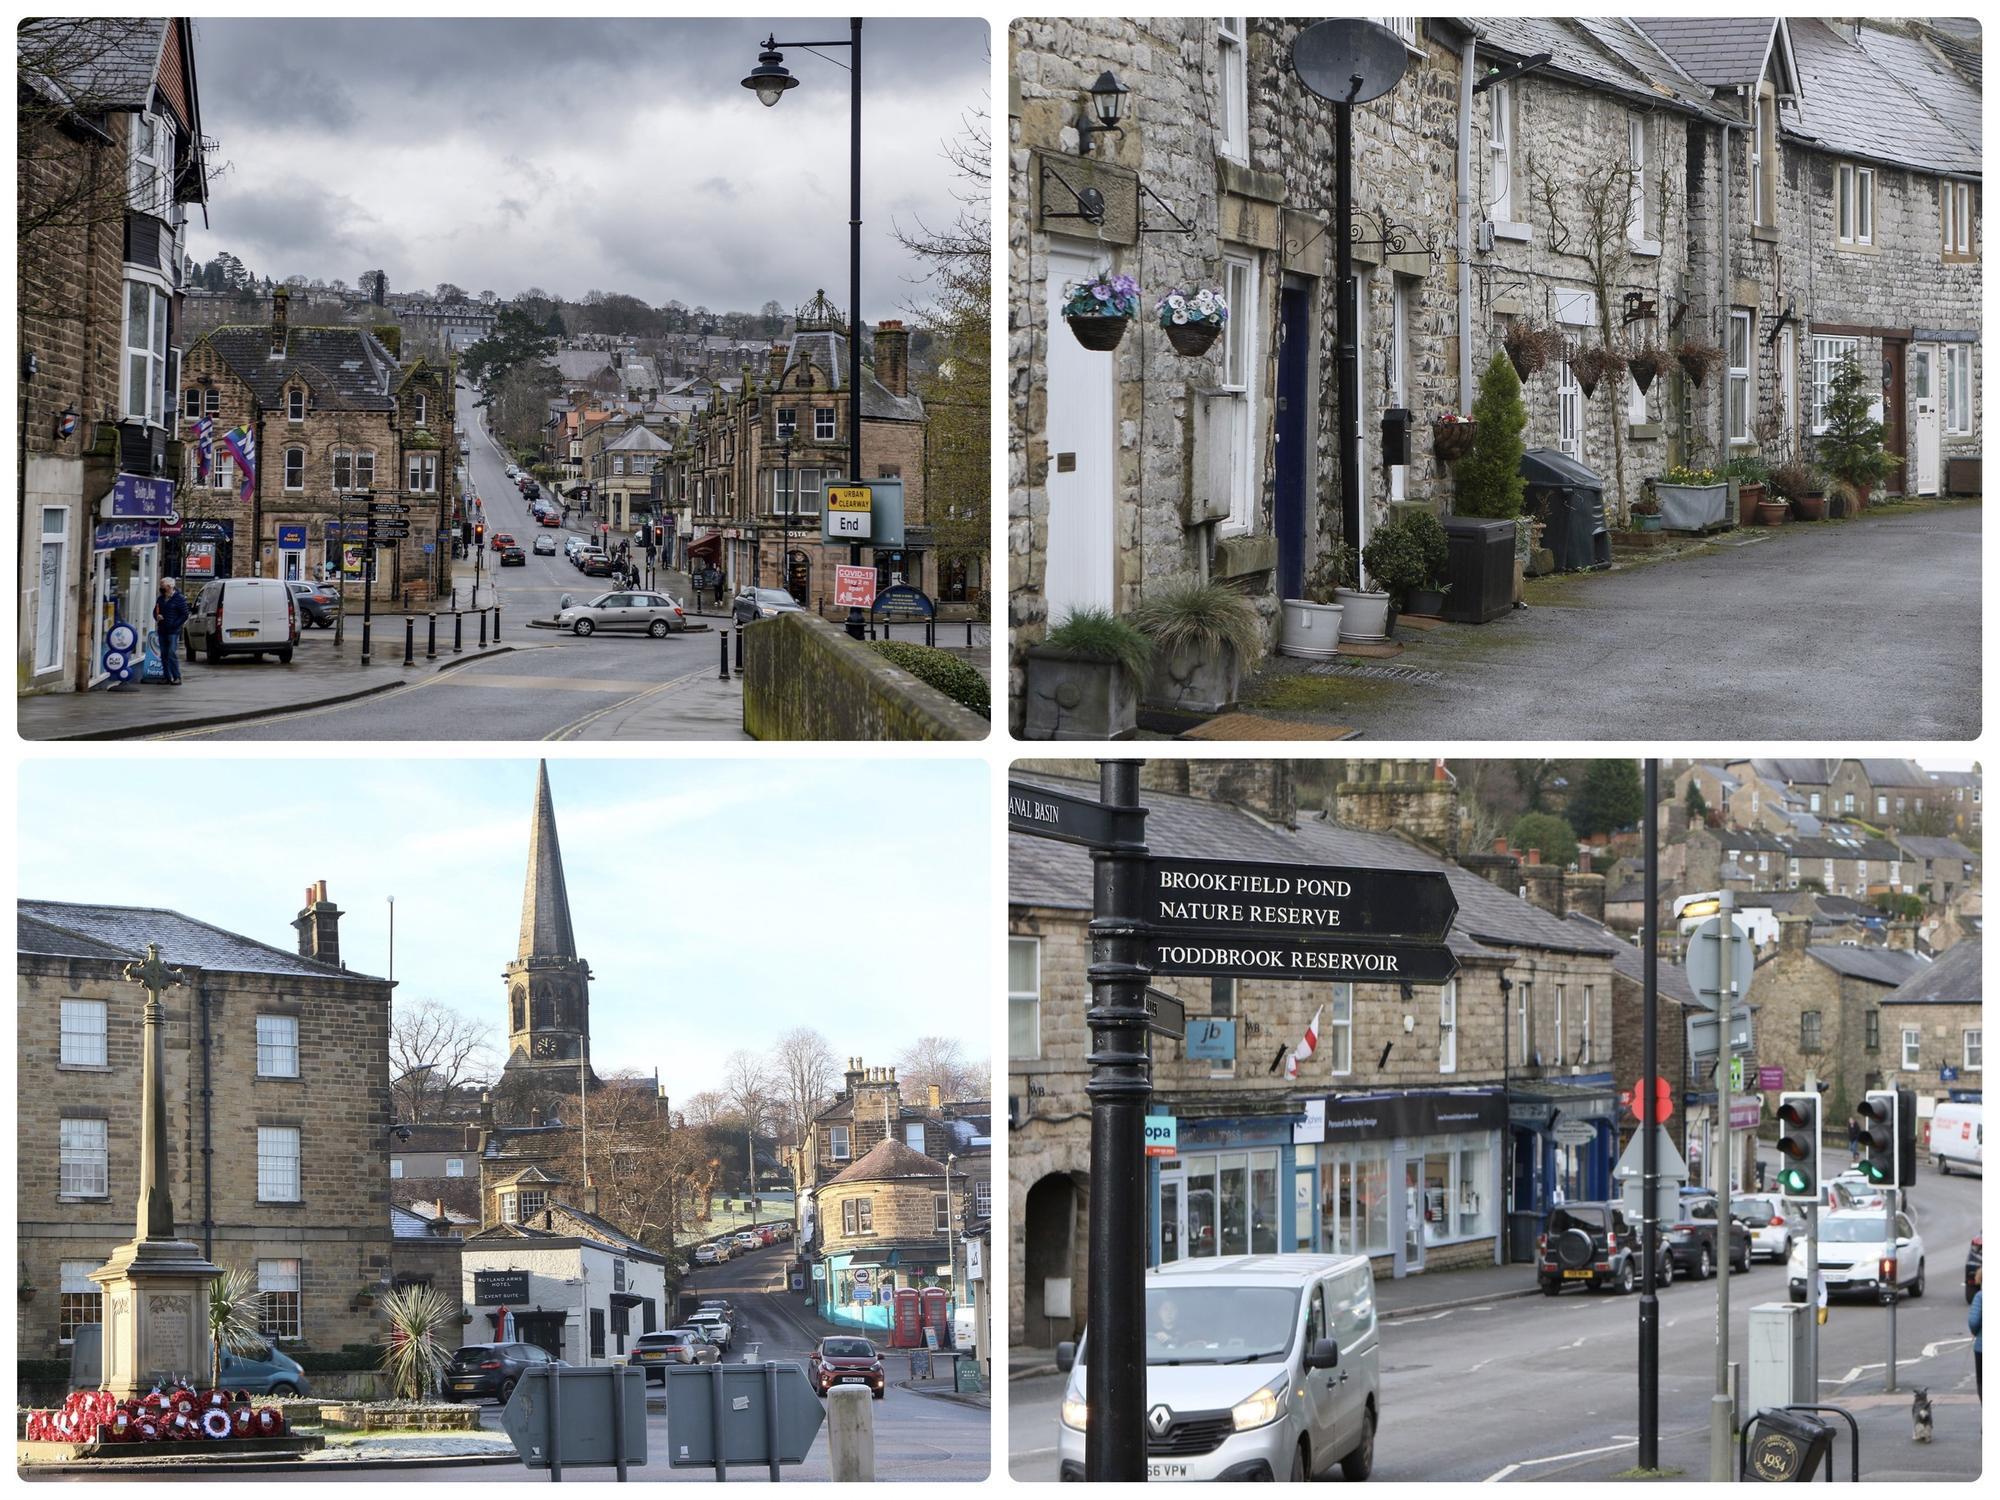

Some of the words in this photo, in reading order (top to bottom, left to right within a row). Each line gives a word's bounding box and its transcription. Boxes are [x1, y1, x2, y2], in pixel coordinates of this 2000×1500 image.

[844, 490, 864, 498] URBAN
[839, 500, 869, 508] CLEARWAY
[840, 517, 859, 531] End
[784, 530, 807, 538] OSTA
[197, 544, 212, 552] LET
[839, 569, 874, 578] COVID-19
[844, 578, 856, 586] Stay
[1008, 796, 1032, 818] ANAL
[1034, 801, 1059, 823] BASIN
[1160, 871, 1290, 895] BROOKFIELD
[1296, 878, 1351, 898] POND
[1159, 901, 1244, 922] NATURE
[1249, 905, 1341, 926] RESERVE
[1158, 946, 1285, 968] TODDBROOK
[1291, 951, 1399, 972] RESERVOIR
[1200, 1022, 1221, 1044] jb
[1145, 1126, 1171, 1140] opa
[1763, 1453, 1786, 1472] 1984
[1164, 1465, 1187, 1477] VPW
